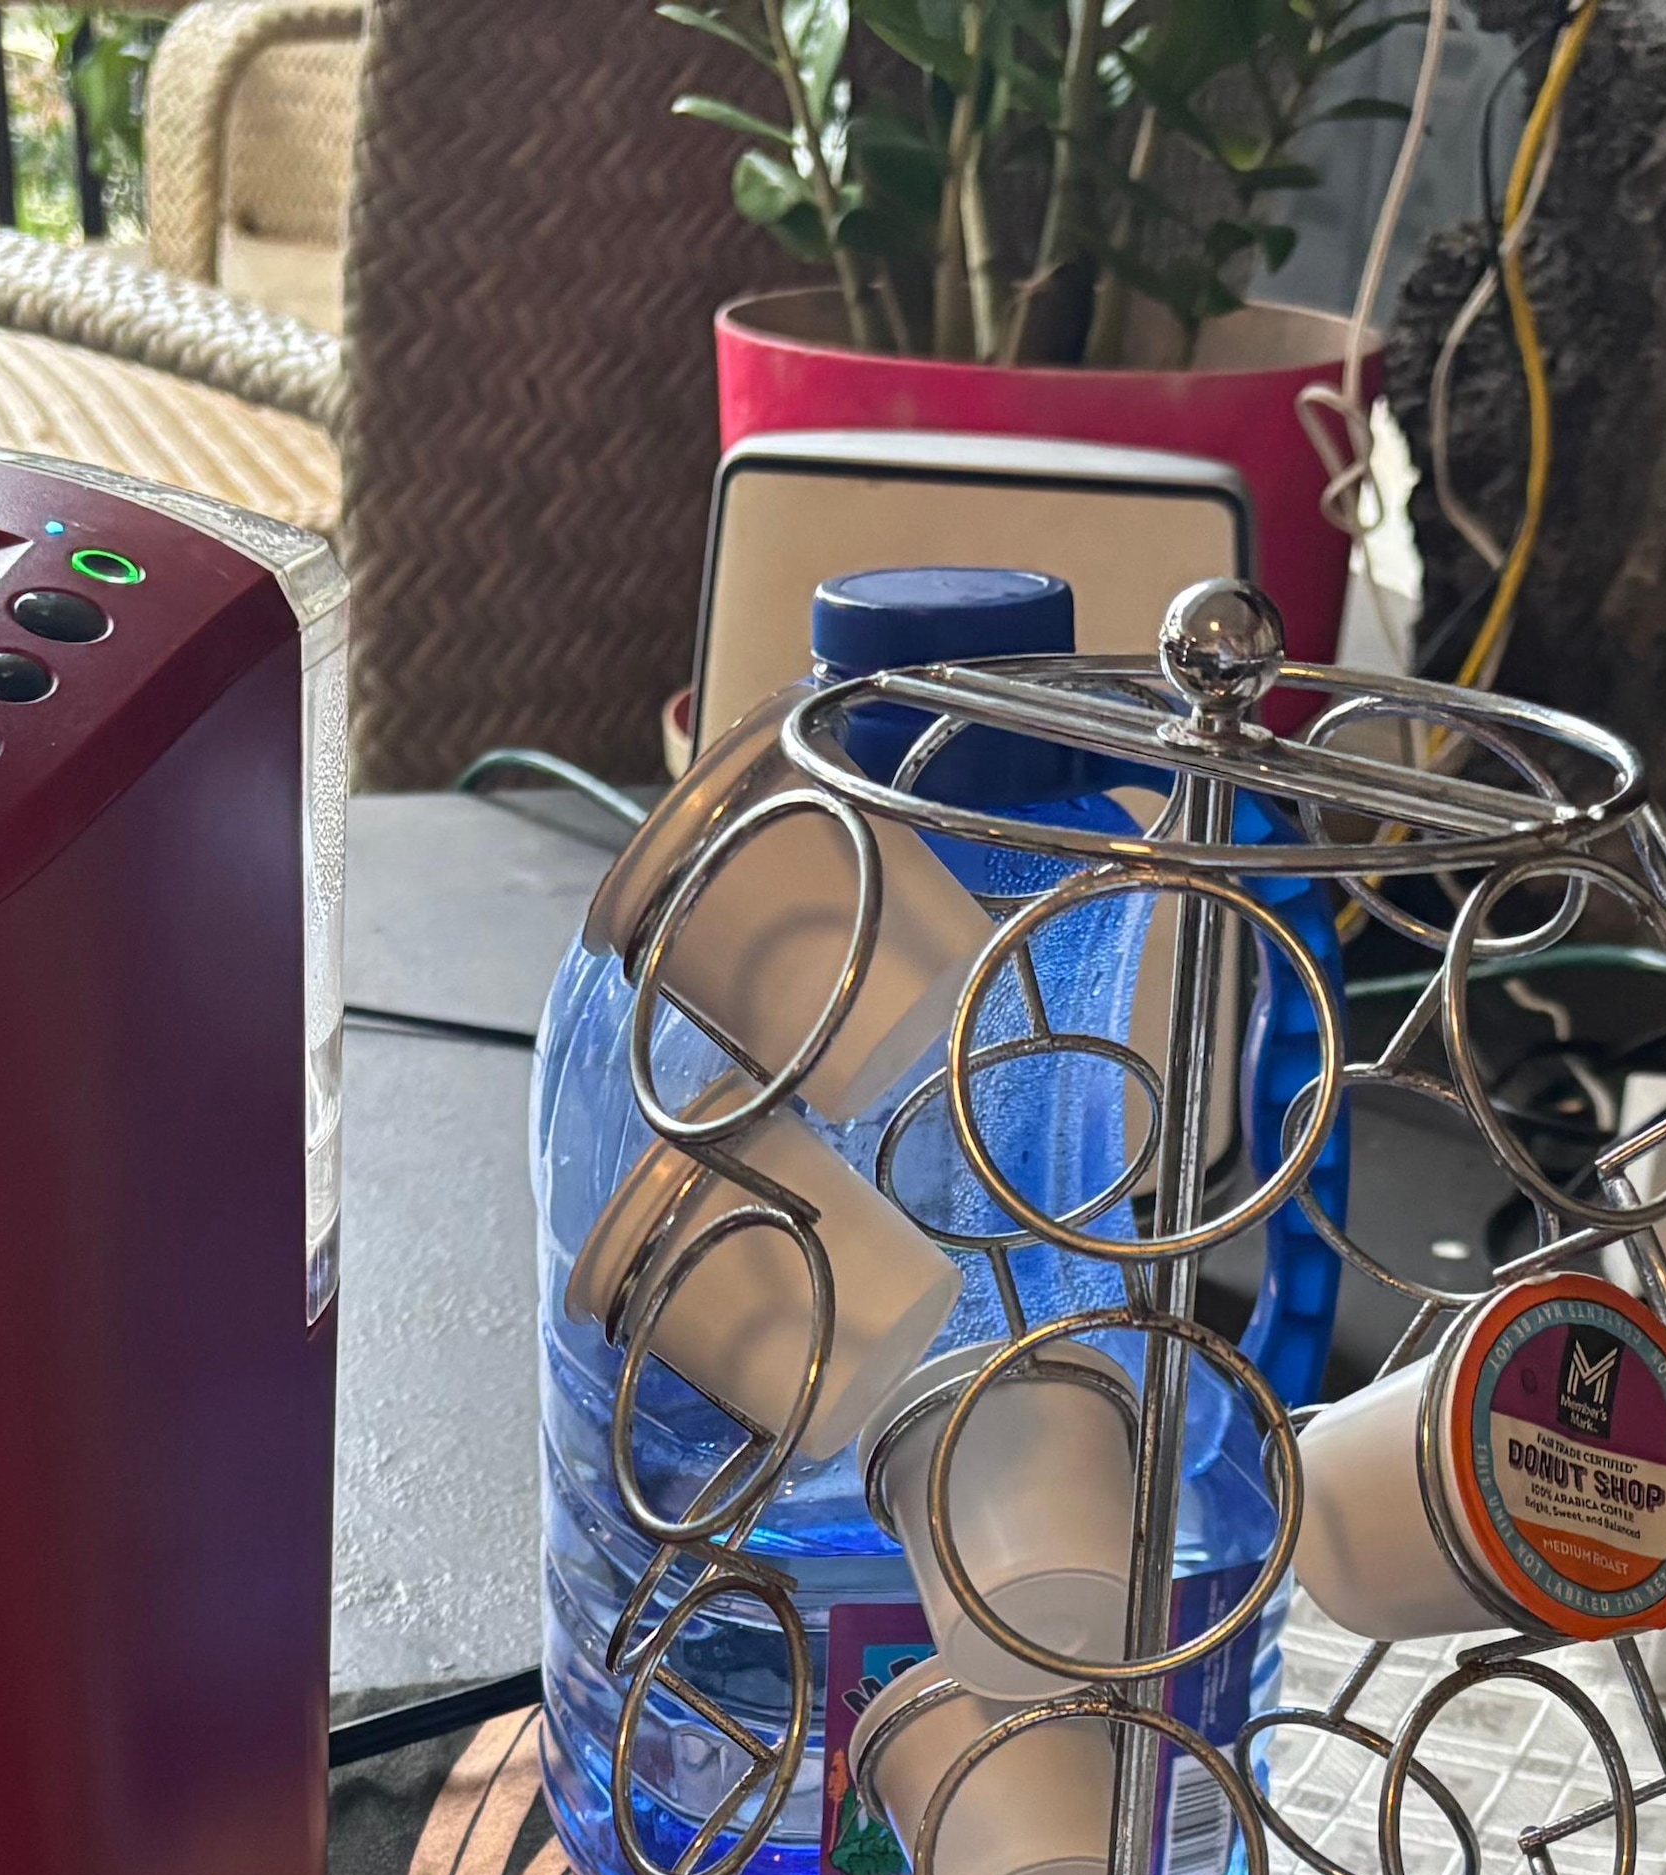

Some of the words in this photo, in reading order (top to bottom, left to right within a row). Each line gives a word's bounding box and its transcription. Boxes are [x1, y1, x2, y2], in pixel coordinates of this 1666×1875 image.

[1500, 1438, 1590, 1492] DONUT
[1514, 1542, 1542, 1577] NOT
[1544, 1572, 1609, 1612] LABELED
[1616, 1590, 1642, 1610] FOR
